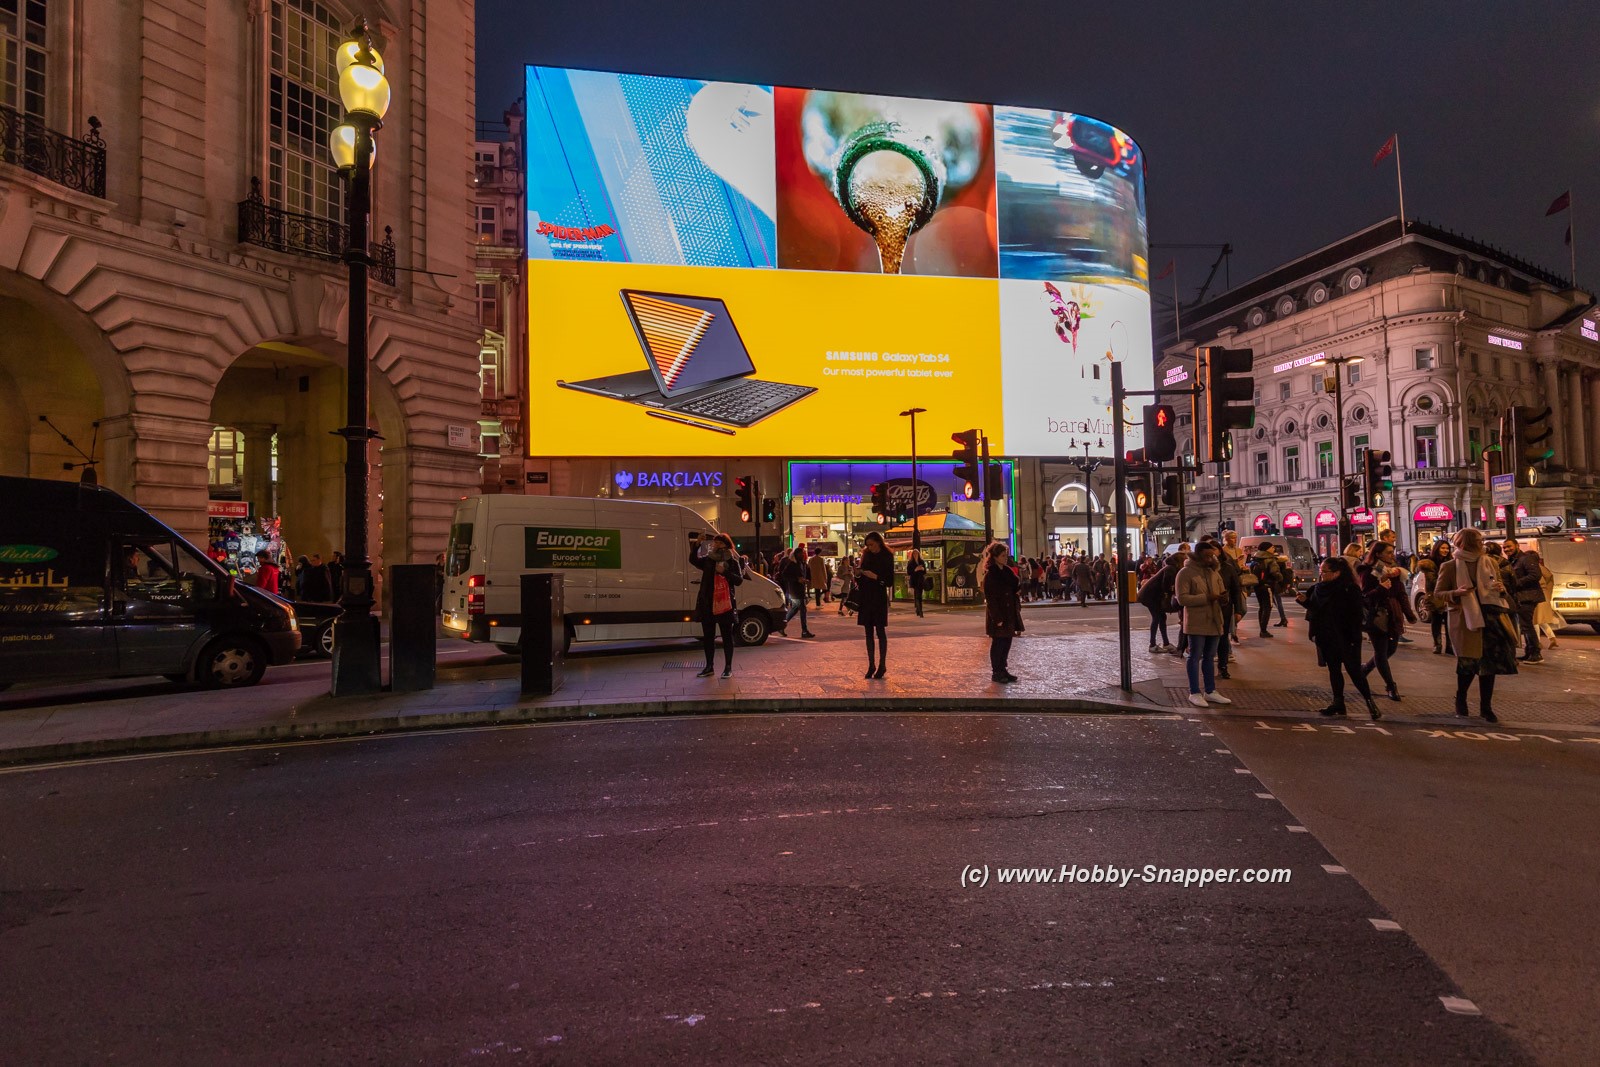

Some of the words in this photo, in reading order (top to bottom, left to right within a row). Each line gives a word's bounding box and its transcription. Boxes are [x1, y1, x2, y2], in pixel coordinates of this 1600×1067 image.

[28, 196, 103, 228] FIRE
[535, 221, 616, 242] SPIDER-MAN
[170, 238, 298, 282] ALLIANCE
[826, 351, 879, 361] SAMSUNG
[882, 352, 918, 364] Galaxy
[919, 353, 937, 362] Tab
[938, 354, 950, 362] S4
[823, 367, 840, 376] Our
[841, 368, 864, 376] most
[866, 368, 905, 378] powerful
[907, 369, 932, 377] tablet
[637, 472, 722, 487] BARCLAYS
[803, 493, 863, 505] pharmacy
[536, 532, 610, 550] Europcar
[552, 553, 586, 561] Europe's
[946, 586, 974, 598] WICKED
